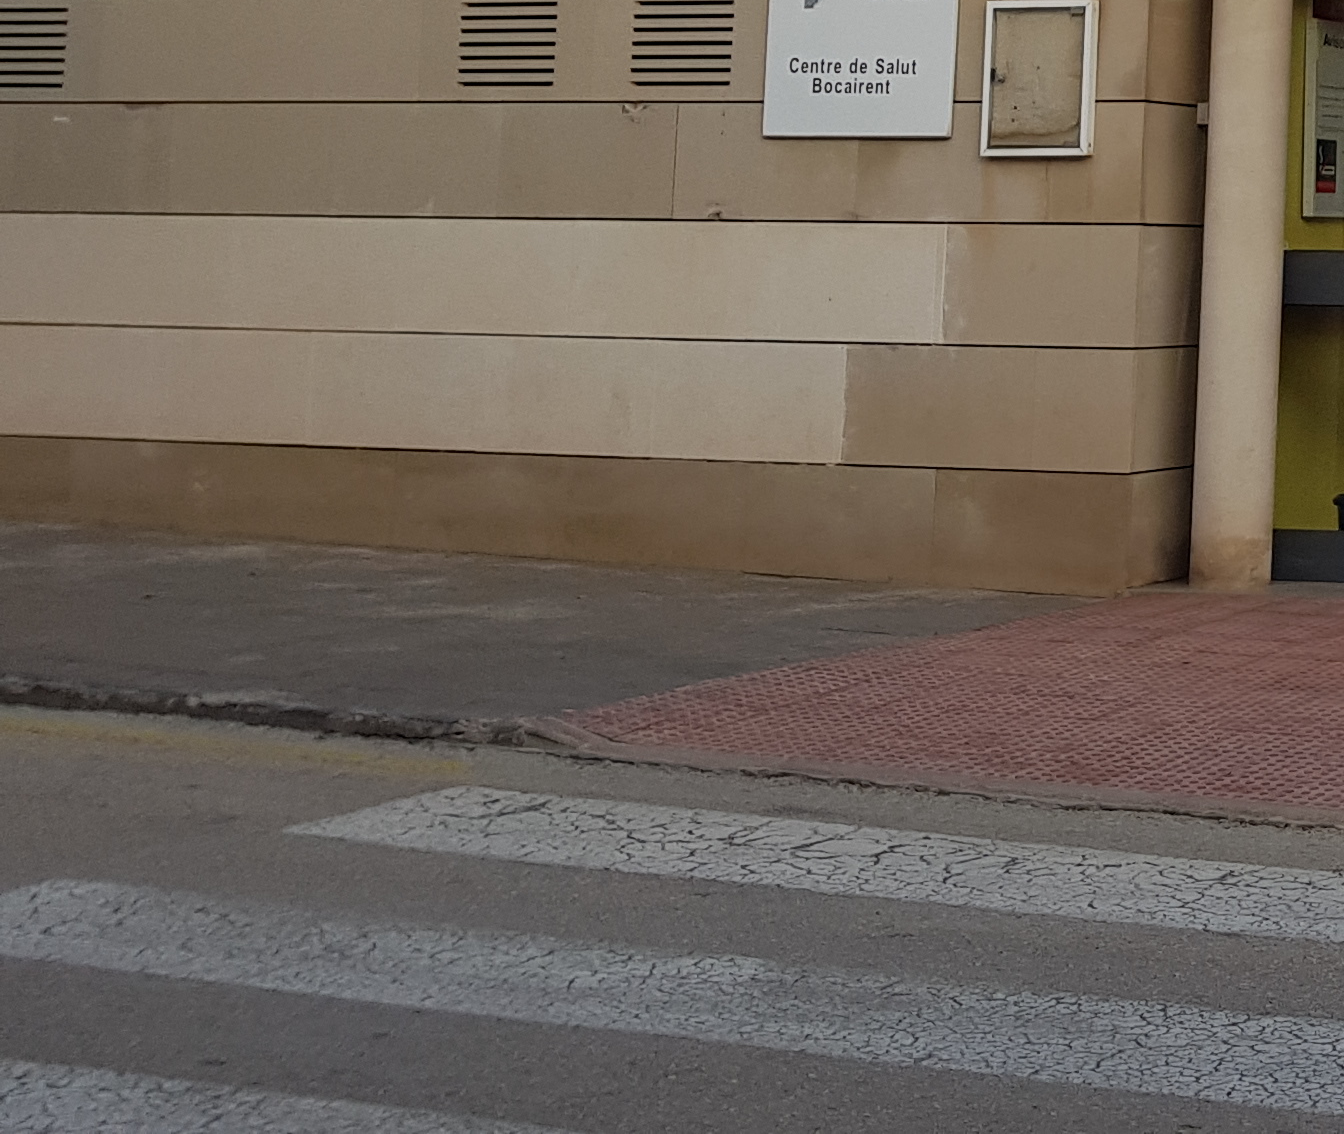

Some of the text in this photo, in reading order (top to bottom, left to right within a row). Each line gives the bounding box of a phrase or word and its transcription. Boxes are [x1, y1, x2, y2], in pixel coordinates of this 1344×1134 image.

[789, 57, 917, 75] Centre de Salut
[812, 77, 891, 94] Bocairent
